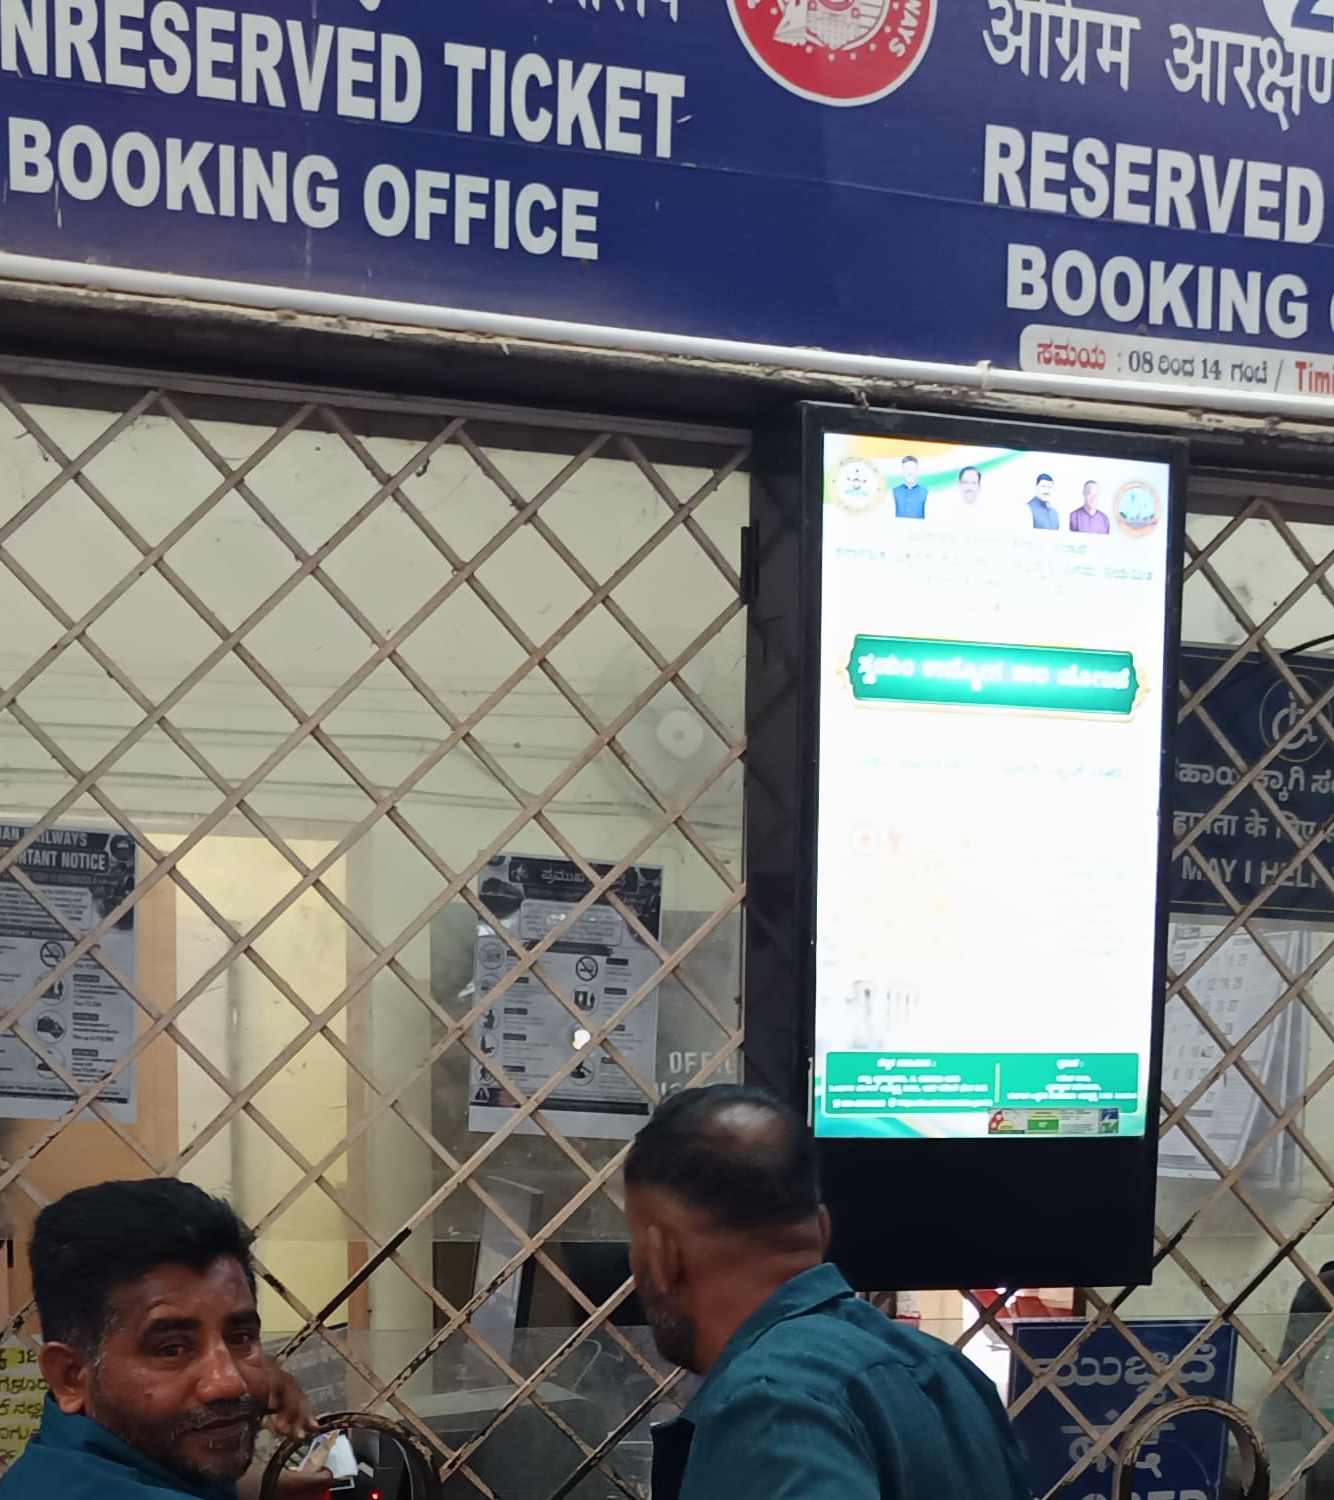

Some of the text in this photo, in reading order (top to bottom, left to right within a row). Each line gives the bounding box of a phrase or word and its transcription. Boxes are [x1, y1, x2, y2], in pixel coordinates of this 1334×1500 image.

[443, 41, 686, 158] TICKET
[7, 115, 601, 261] BOOKING OFFICE
[982, 124, 1325, 244] RESERVED
[1006, 243, 1310, 339] BOOKING
[1128, 349, 1155, 375] 08
[1201, 357, 1222, 381] 14
[1244, 808, 1269, 840] के
[61, 852, 106, 871] NOTICE
[1244, 860, 1252, 884] I
